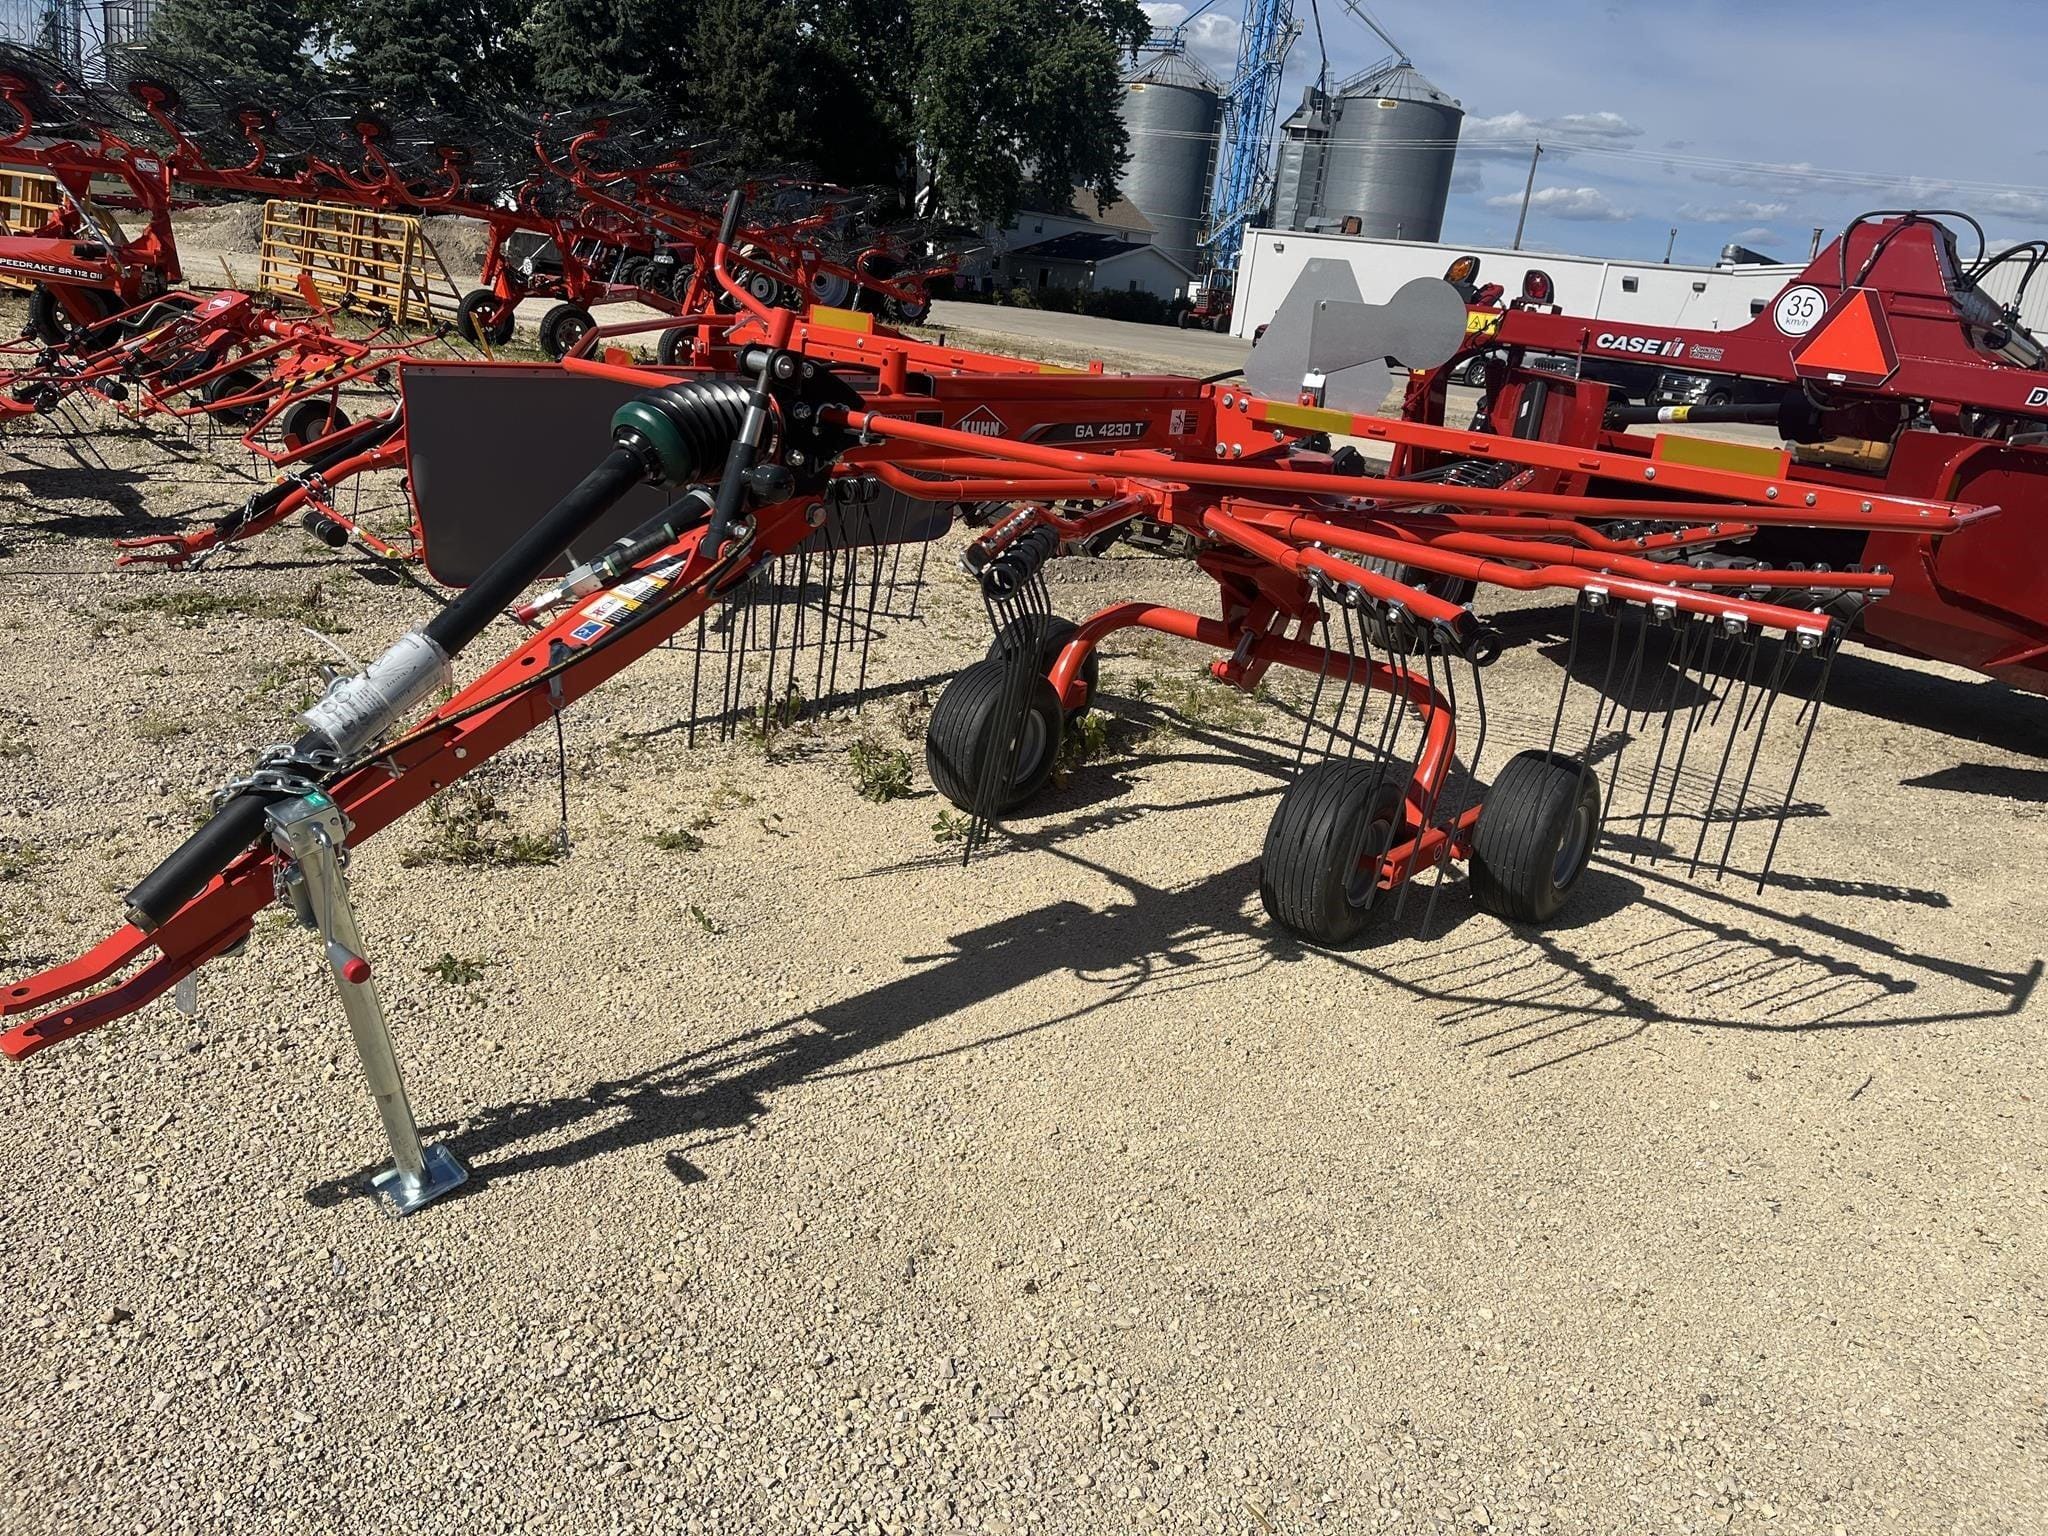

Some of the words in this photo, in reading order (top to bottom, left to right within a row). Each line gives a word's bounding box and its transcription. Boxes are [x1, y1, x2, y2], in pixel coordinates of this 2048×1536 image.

[58, 267, 72, 275] SR
[73, 270, 88, 278] 112
[1787, 295, 1817, 318] 35
[1785, 317, 1809, 327] km/h
[1596, 333, 1661, 355] CASE
[961, 420, 1000, 436] KUHN
[1075, 425, 1095, 438] GA
[1098, 423, 1132, 437] 4230
[1135, 423, 1144, 436] T
